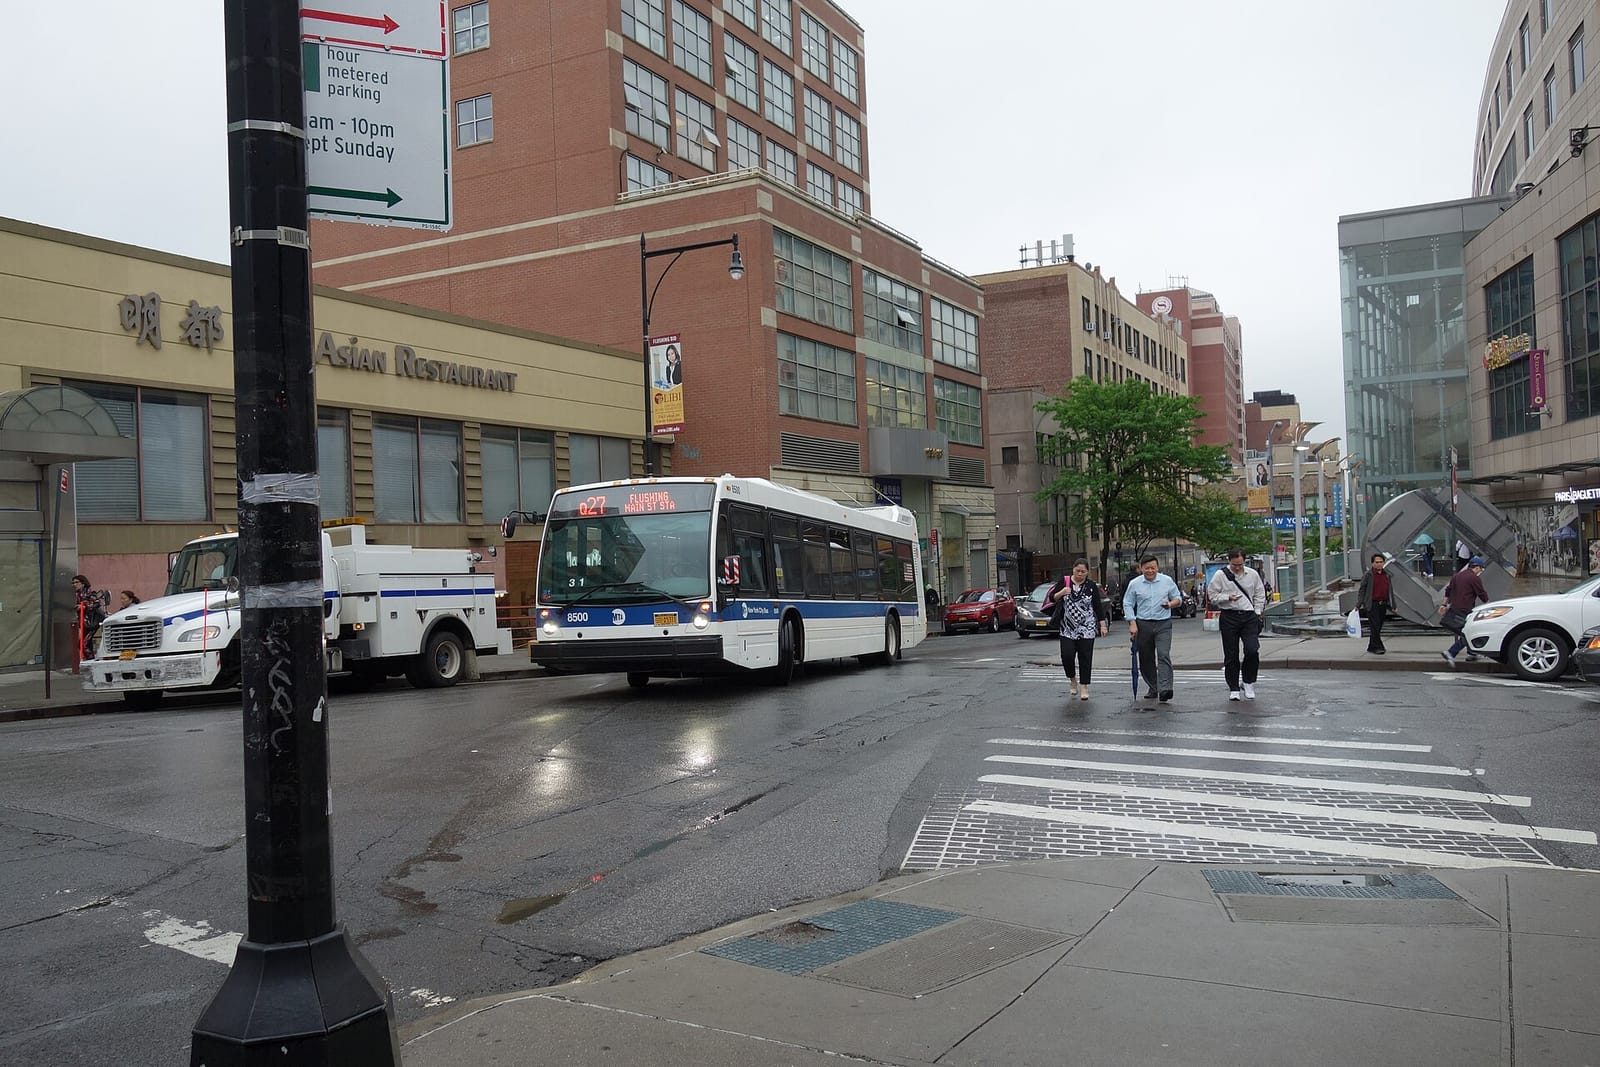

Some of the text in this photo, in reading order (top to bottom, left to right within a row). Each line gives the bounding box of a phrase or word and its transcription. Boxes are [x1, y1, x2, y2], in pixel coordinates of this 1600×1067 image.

[327, 45, 360, 63] hour
[328, 66, 388, 85] metered
[328, 84, 381, 104] parking
[309, 115, 334, 131] am
[351, 117, 394, 139] 10pm
[334, 137, 395, 163] Sunday
[394, 344, 518, 392] RESTAURANT
[579, 495, 606, 516] Q27
[629, 491, 670, 503] FLUSHING
[1554, 491, 1571, 502] PARIS
[624, 500, 676, 513] MAIN ST STA
[567, 612, 589, 622] 8500
